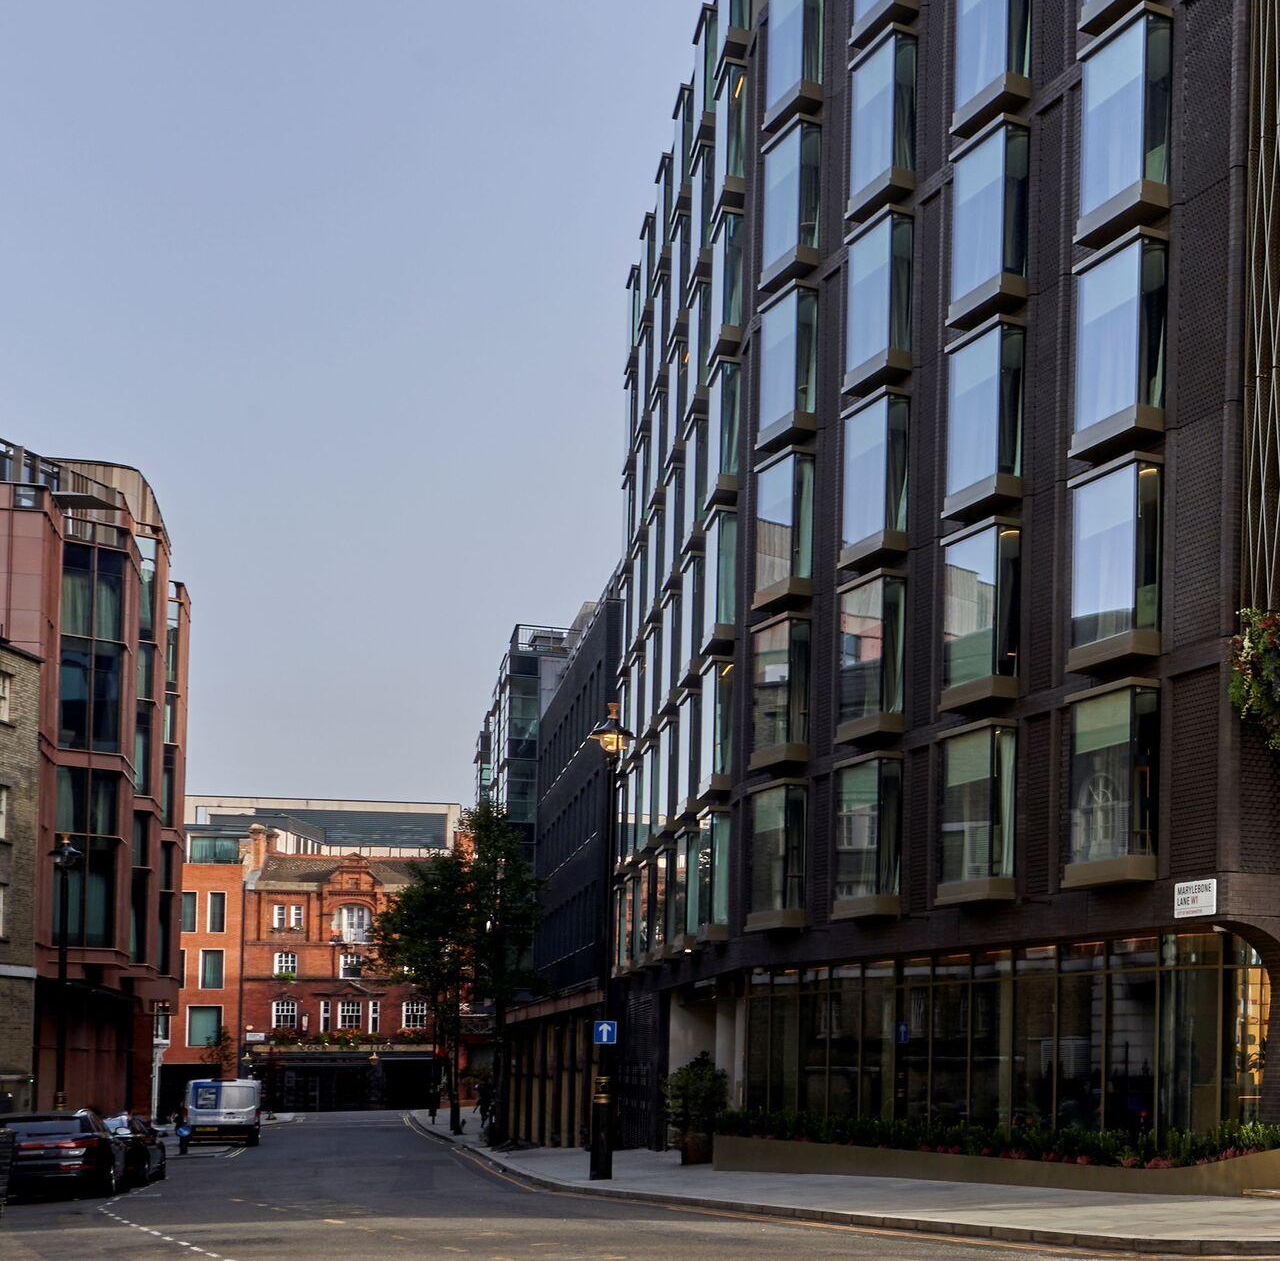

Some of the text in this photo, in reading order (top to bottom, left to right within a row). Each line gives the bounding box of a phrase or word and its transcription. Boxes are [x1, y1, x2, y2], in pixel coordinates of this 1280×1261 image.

[1177, 883, 1212, 896] MARYLEBONE
[1177, 896, 1199, 906] LANE W1
